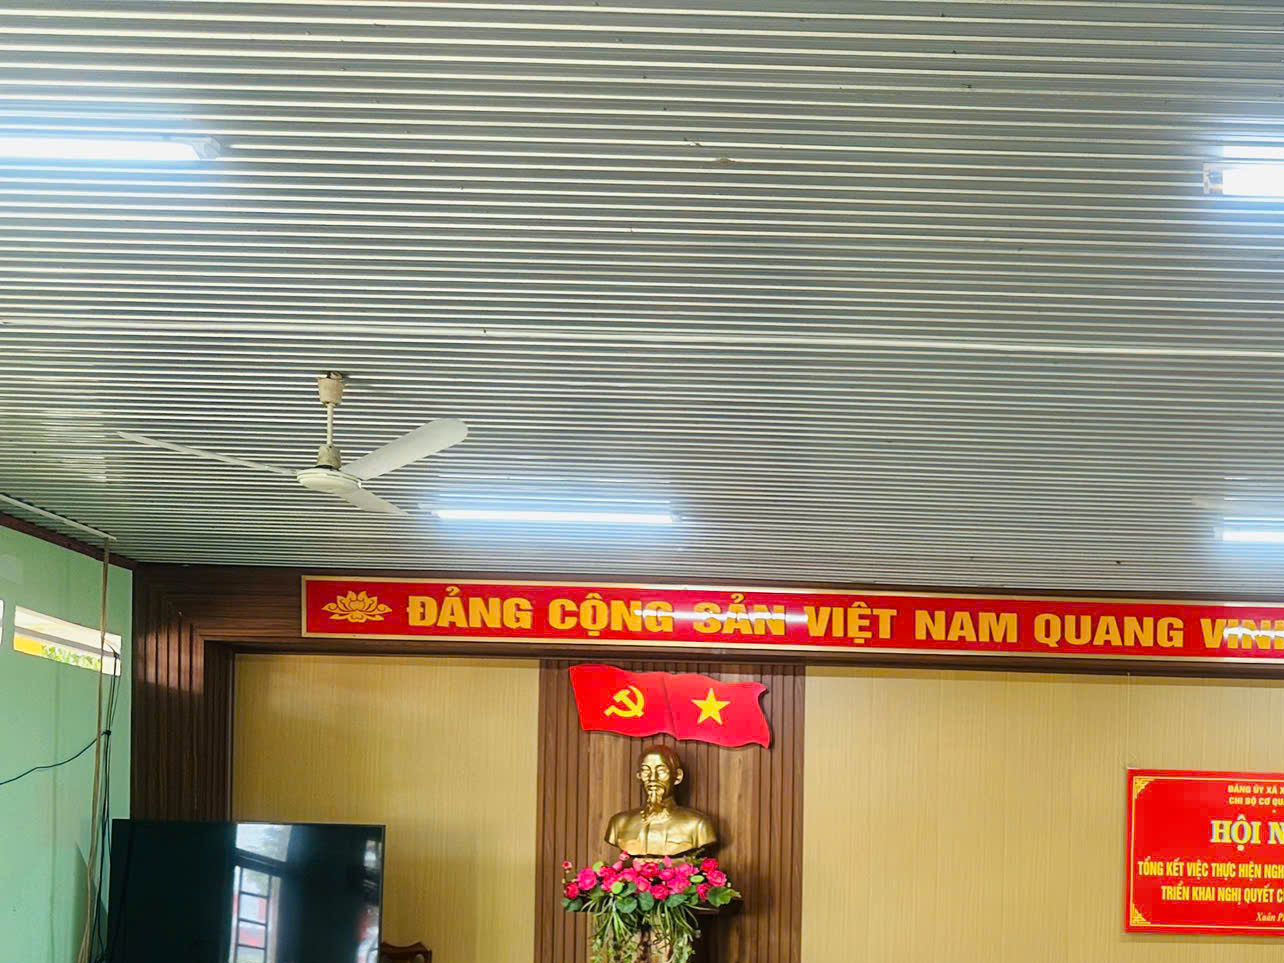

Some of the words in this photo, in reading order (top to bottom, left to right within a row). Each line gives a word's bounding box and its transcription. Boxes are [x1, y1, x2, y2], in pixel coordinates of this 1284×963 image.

[407, 585, 531, 629] ĐẢNG
[548, 593, 673, 638] CỘNG
[693, 594, 786, 636] SẢN
[804, 602, 897, 644] VIỆT
[914, 610, 1017, 643] NAM
[1033, 612, 1184, 649] QUANG
[1229, 797, 1243, 805] CHI
[1245, 796, 1256, 807] BỘ
[1259, 797, 1271, 806] CƠ
[1210, 814, 1261, 852] HỘI
[1137, 856, 1164, 876] TỔNG
[1166, 857, 1184, 876] KẾT
[1186, 859, 1208, 880] VIỆC
[1211, 862, 1236, 880] THỰC
[1238, 861, 1261, 881] HIỆN
[1161, 880, 1190, 900] TRIỂN
[1192, 887, 1215, 901] KHAI
[1217, 887, 1241, 905] NGHỊ
[1244, 883, 1274, 904] QUYẾT
